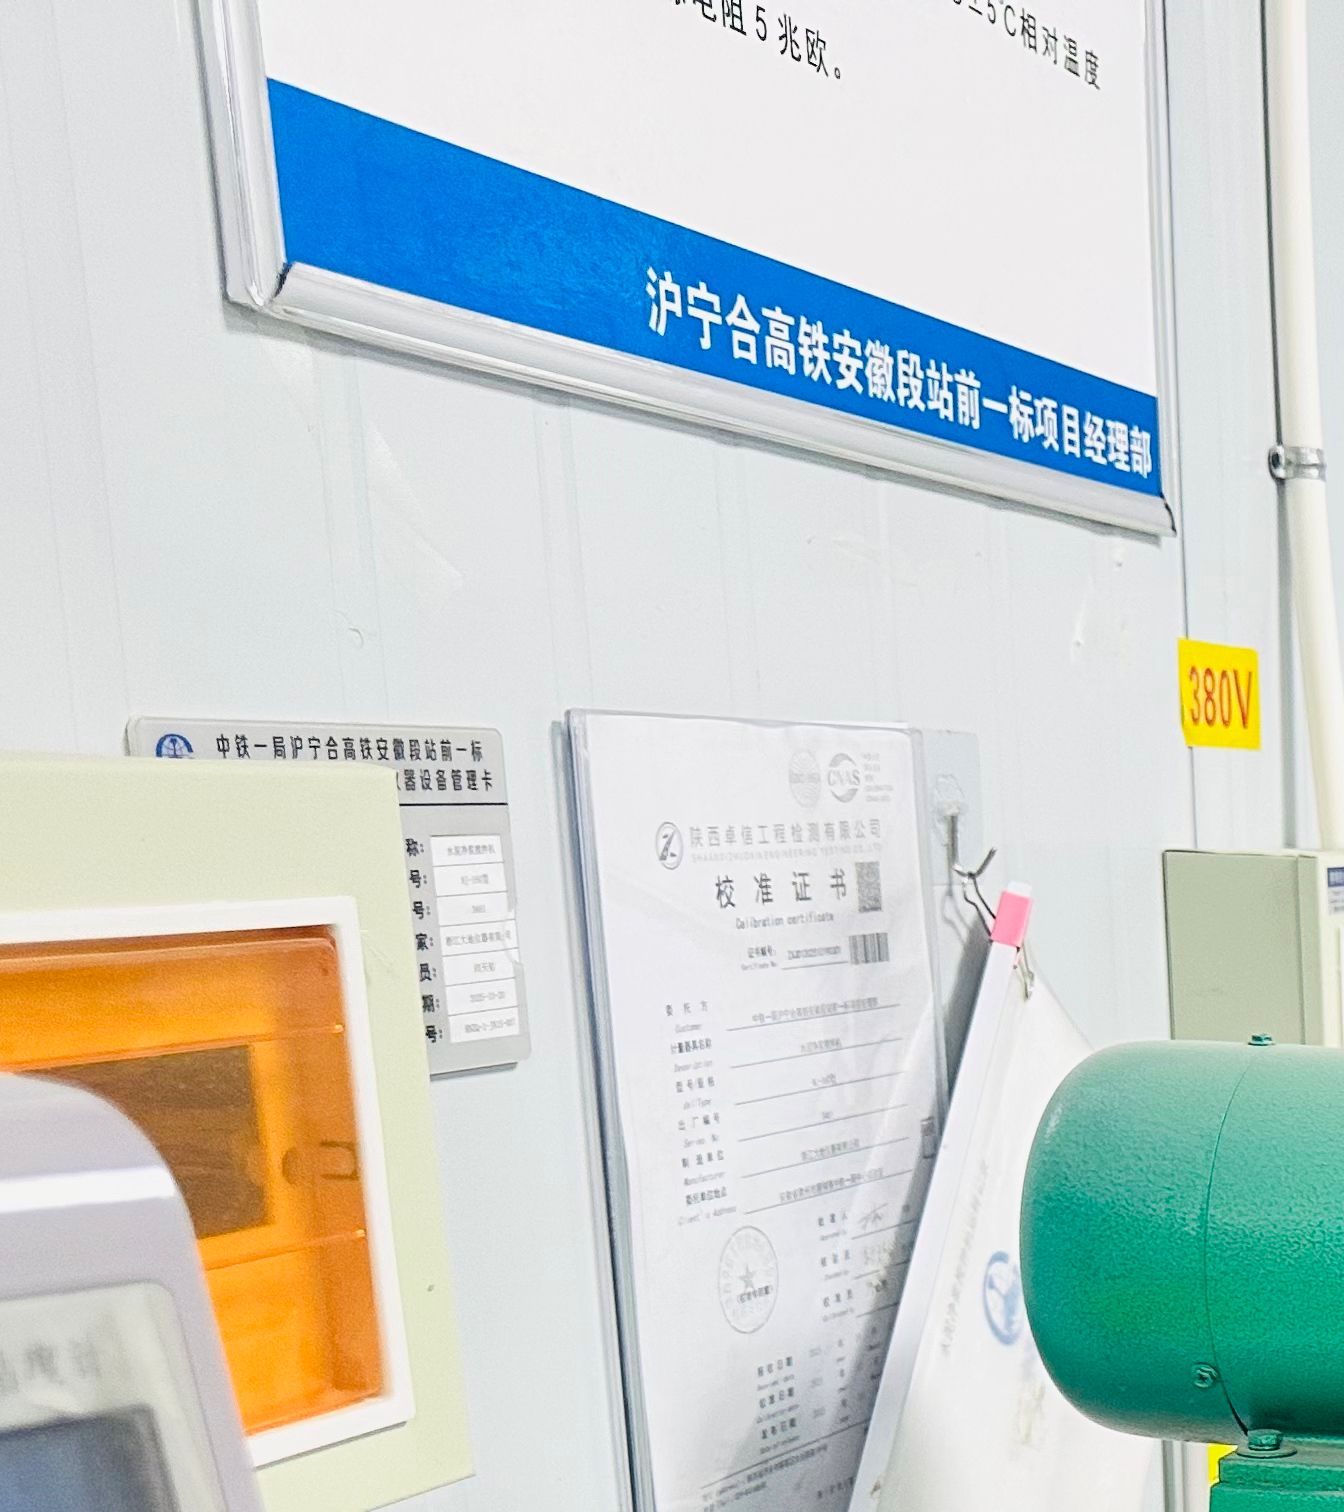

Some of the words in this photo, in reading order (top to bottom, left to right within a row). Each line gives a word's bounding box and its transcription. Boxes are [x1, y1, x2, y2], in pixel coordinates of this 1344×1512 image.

[645, 265, 1153, 478] 沪宁合高铁安徽段站前一标项目经理部
[1190, 666, 1252, 729] 380V
[216, 734, 482, 762] 中铁一局沪宁合高铁安徽段站前一标
[395, 769, 492, 792] 器设备管理卡
